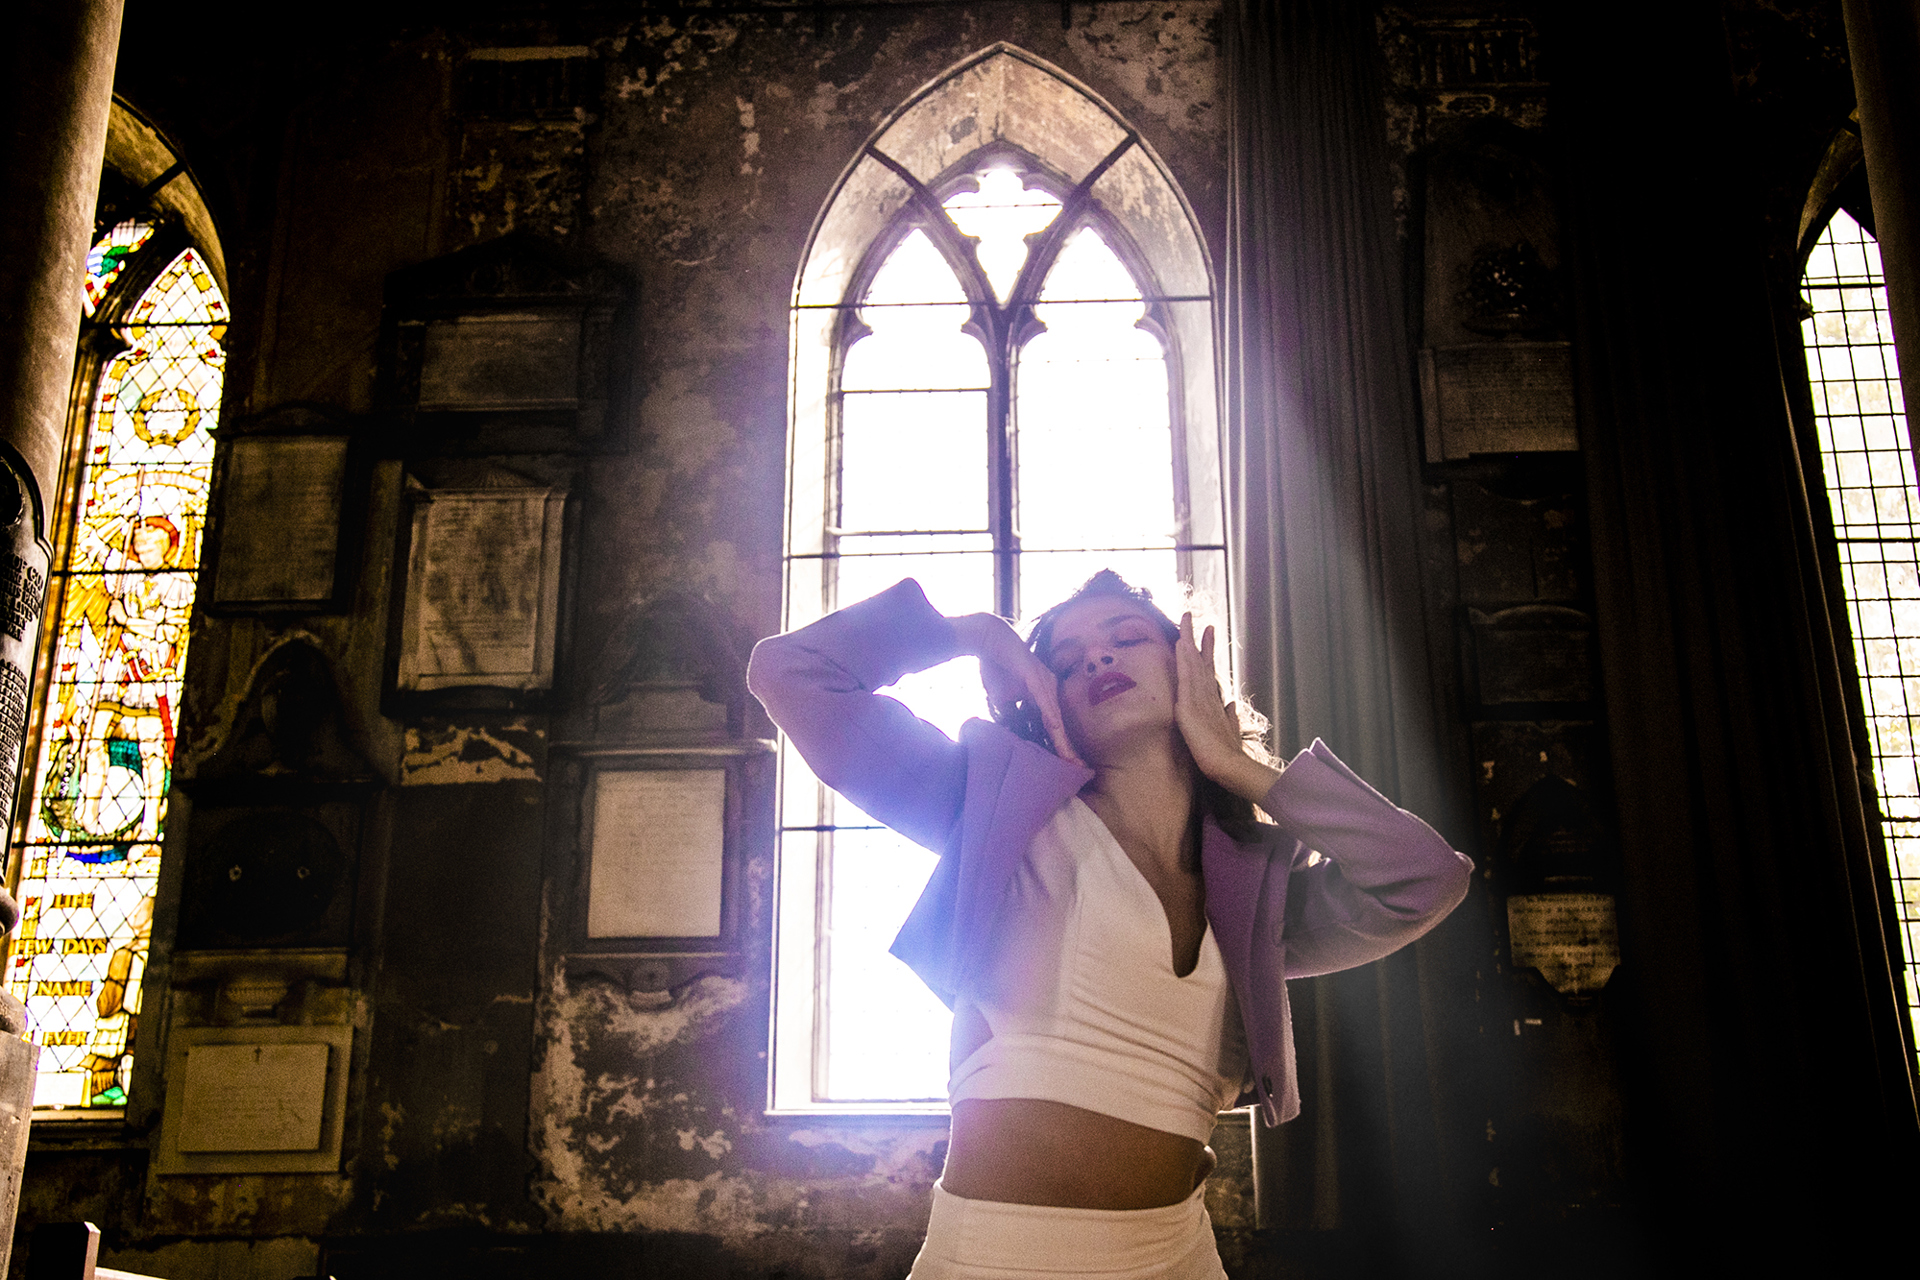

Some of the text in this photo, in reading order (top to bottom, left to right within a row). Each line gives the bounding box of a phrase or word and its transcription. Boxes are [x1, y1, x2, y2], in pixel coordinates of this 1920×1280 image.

[54, 894, 93, 908] LIFE
[15, 939, 107, 954] FEW DAYS
[38, 982, 92, 996] NAME
[43, 1031, 87, 1045] EVER
